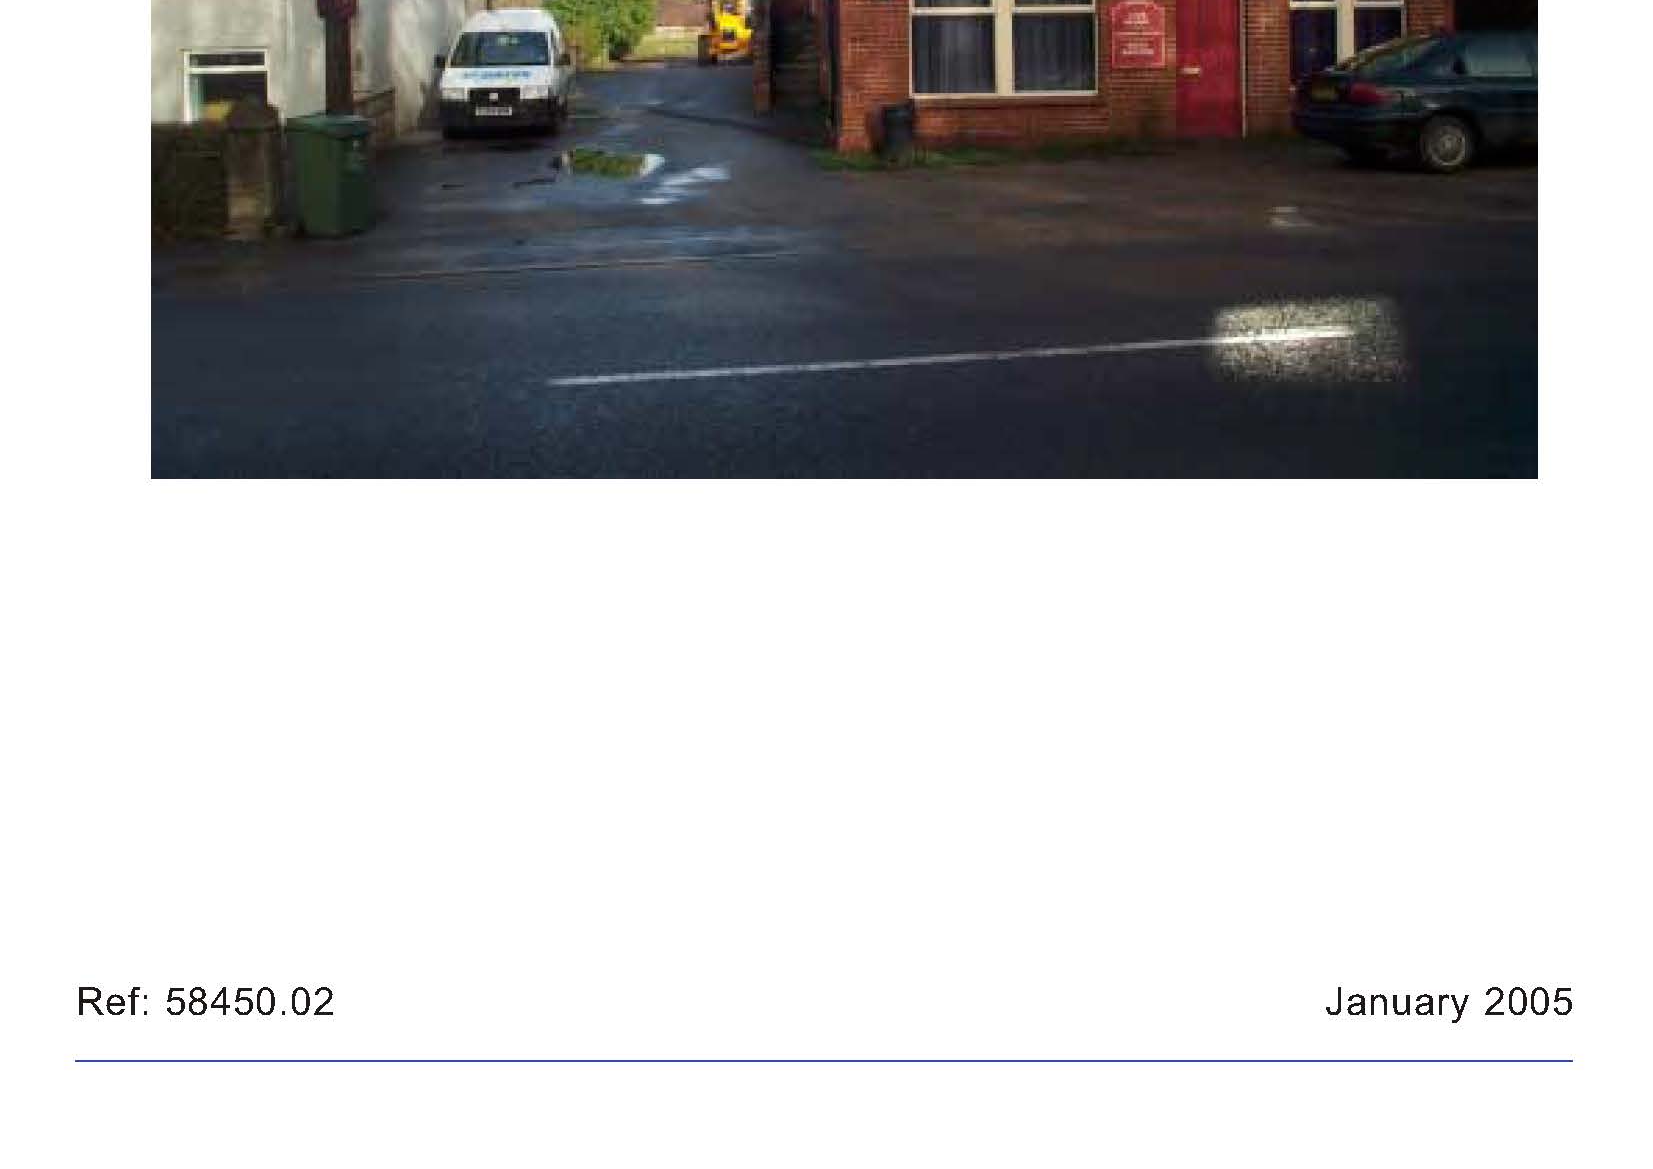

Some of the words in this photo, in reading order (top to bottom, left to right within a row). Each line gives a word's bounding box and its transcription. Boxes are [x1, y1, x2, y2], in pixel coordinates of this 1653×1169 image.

[79, 987, 147, 1015] Ref:
[167, 987, 333, 1015] 58450.02
[1326, 987, 1469, 1023] January
[1485, 987, 1573, 1015] 2005
